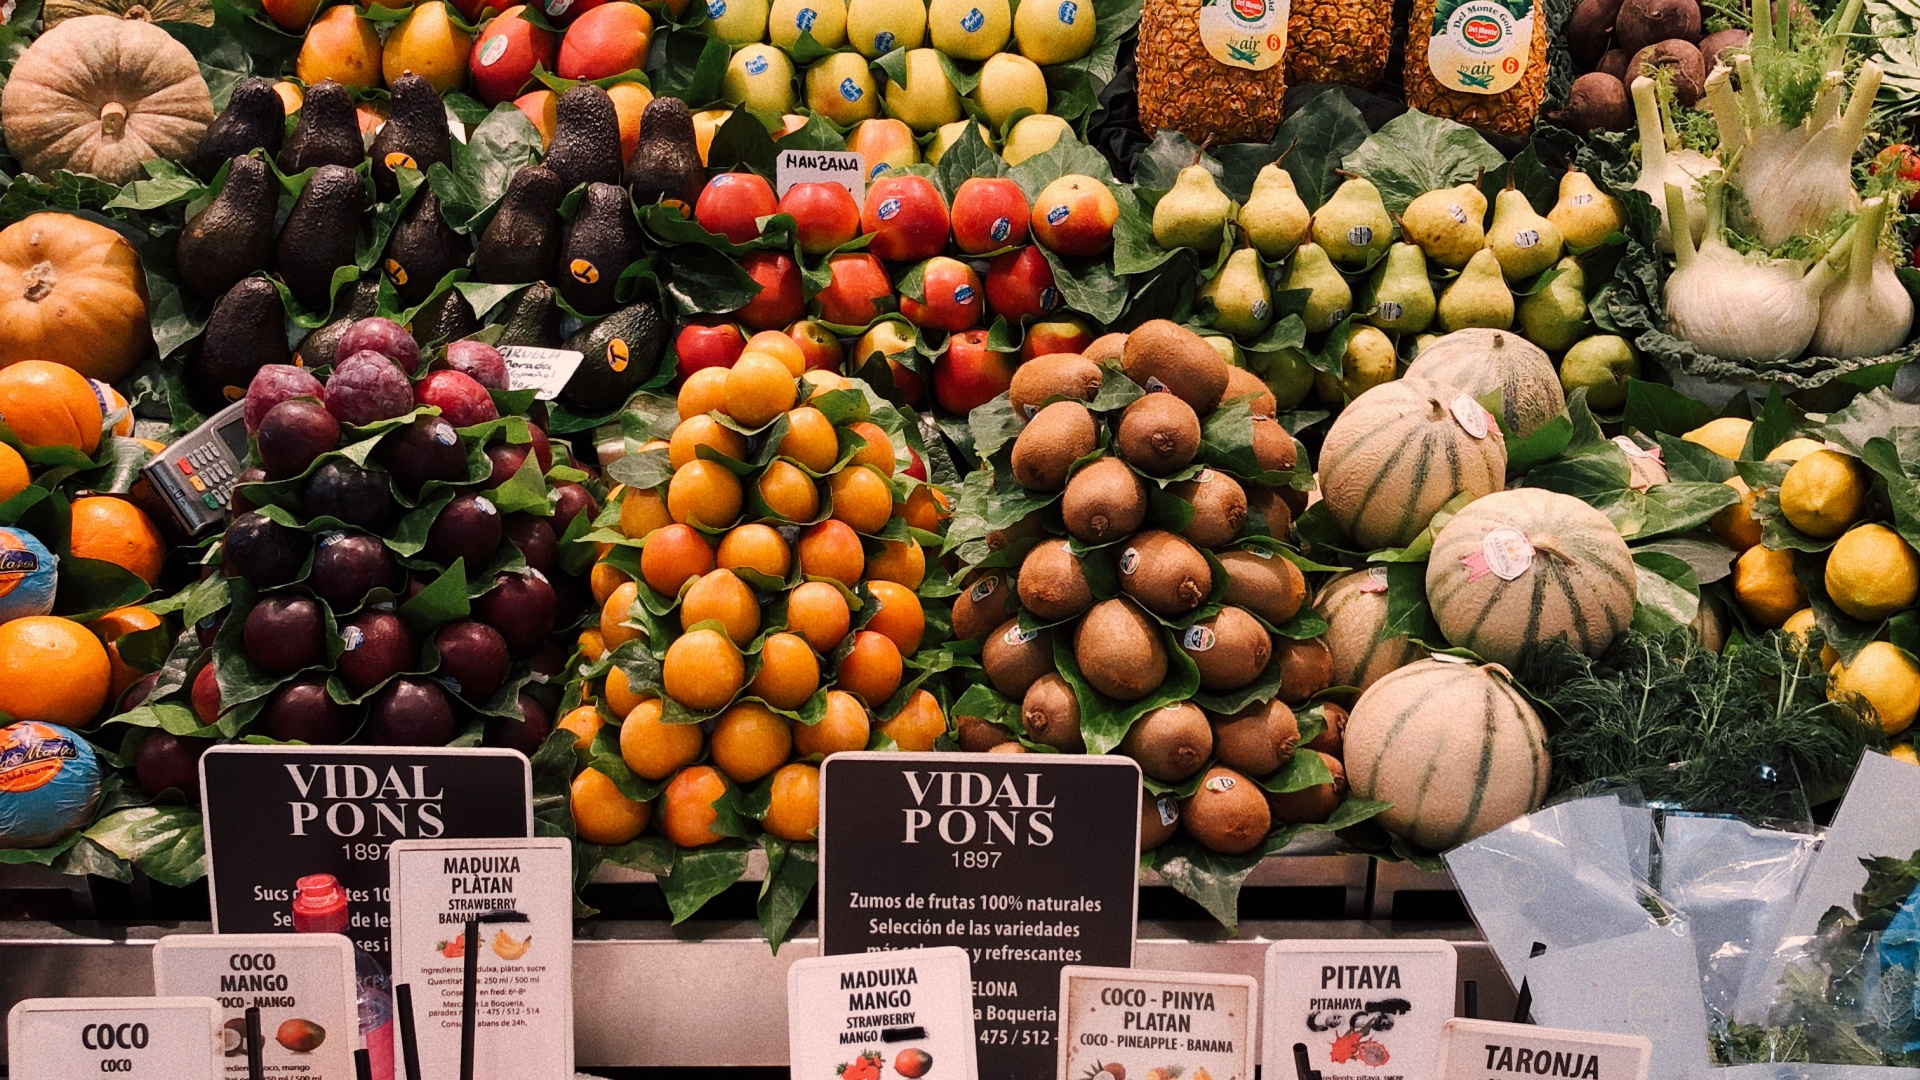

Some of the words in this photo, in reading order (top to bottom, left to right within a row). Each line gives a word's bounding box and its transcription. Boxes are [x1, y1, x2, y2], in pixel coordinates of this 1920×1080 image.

[1453, 12, 1467, 28] Del
[1467, 5, 1498, 16] Monte
[1500, 14, 1513, 35] Gold
[1479, 27, 1498, 36] Monte
[1230, 37, 1238, 46] by
[1240, 36, 1260, 50] air
[1270, 36, 1278, 50] 6
[1460, 63, 1470, 73] by
[1471, 61, 1495, 76] air
[1506, 59, 1515, 73] 6
[283, 764, 444, 800] VIDAL
[901, 771, 1056, 808] VIDAL
[287, 802, 444, 838] PONS
[901, 809, 1054, 846] PONS
[443, 856, 521, 874] MADUIXA
[952, 851, 1002, 868] 1897
[254, 885, 289, 901] Sucs
[451, 874, 513, 894] PLÀTAN
[448, 898, 517, 910] STRAWBERRY
[850, 892, 901, 909] Zumos
[905, 893, 924, 909] de
[928, 893, 975, 910] frutas
[980, 895, 1023, 910] 100%
[1027, 896, 1101, 912] naturales
[351, 912, 370, 927] de
[374, 912, 391, 927] le
[869, 918, 941, 935] Selección
[946, 919, 965, 935] de
[969, 919, 991, 935] las
[995, 921, 1080, 937] variedades
[230, 953, 275, 971] COCO
[972, 948, 982, 964] y
[986, 944, 1082, 961] refrescantes
[221, 974, 288, 992] MANGO
[499, 976, 508, 984] ml
[840, 967, 918, 990] MADUIXA
[1321, 965, 1401, 989] PITAYA
[971, 981, 1018, 997] ELONA
[253, 996, 295, 1008] MANGO
[849, 989, 911, 1011] MANGO
[1101, 987, 1146, 1007] COCO
[1162, 991, 1215, 1011] PINYA
[1310, 998, 1362, 1010] PITAHAYA
[429, 1009, 457, 1017] parades
[846, 1012, 915, 1029] STRAWBERRY
[987, 1005, 1057, 1024] Boqueria
[1124, 1011, 1190, 1033] PLATAN
[82, 1023, 149, 1050] COCO
[840, 1030, 878, 1044] MANGO
[980, 1029, 1008, 1044] 475
[1011, 1029, 1019, 1045] /
[1022, 1030, 1049, 1045] 512
[1080, 1033, 1107, 1046] COCO
[1117, 1035, 1177, 1050] PINEAPPLE
[1187, 1039, 1233, 1053] BANANA
[101, 1059, 132, 1072] COCO
[282, 1064, 311, 1072] mango
[1485, 1044, 1599, 1080] TARONJA
